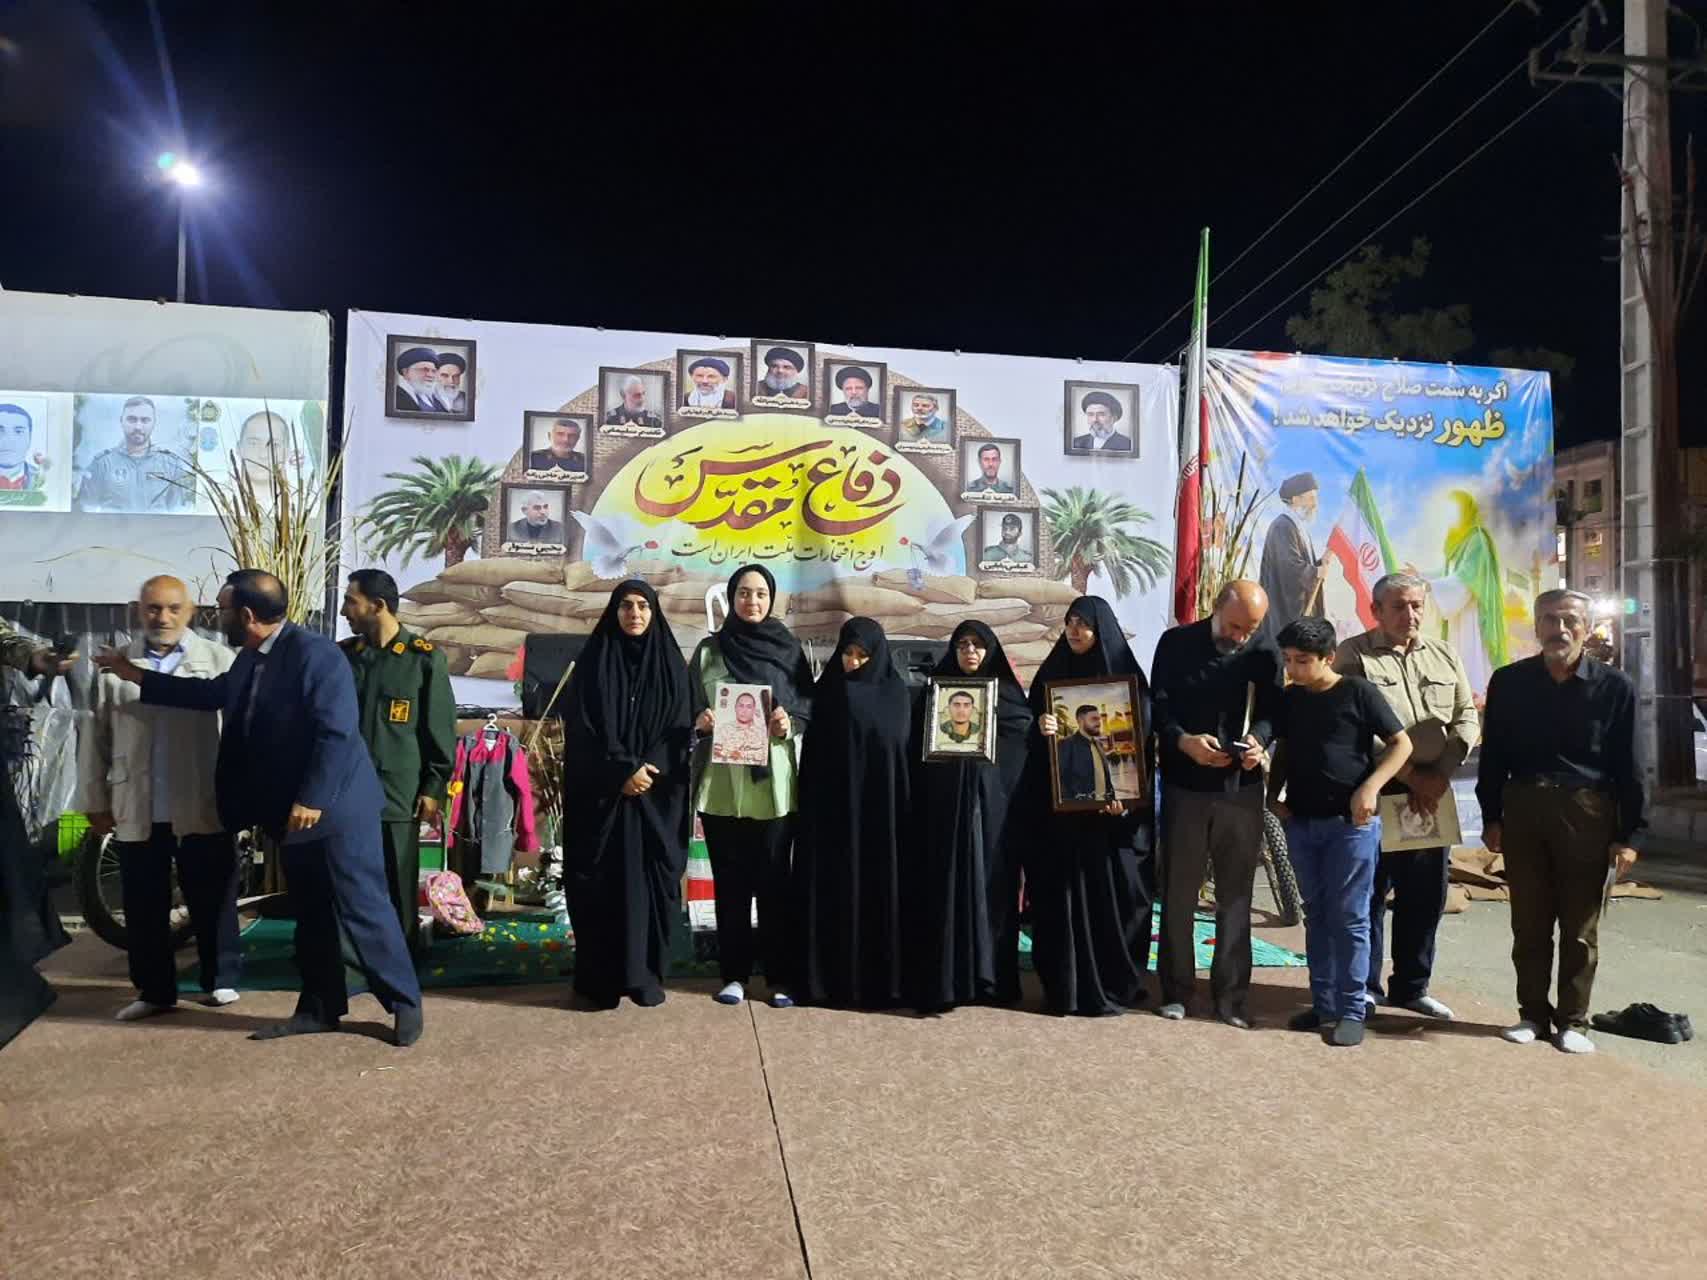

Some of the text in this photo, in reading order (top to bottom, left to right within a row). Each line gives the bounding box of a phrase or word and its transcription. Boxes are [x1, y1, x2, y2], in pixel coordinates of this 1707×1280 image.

[1425, 383, 1466, 397] سمت
[1468, 384, 1484, 404] به
[1484, 380, 1508, 404] اگر
[1312, 406, 1372, 437] خواهد
[1374, 408, 1434, 439] نزدیک
[1433, 408, 1506, 447] ظهور
[802, 449, 904, 536] دفاع
[670, 538, 718, 562] است
[708, 545, 752, 566] ایران
[793, 539, 854, 562] افتخارات
[853, 545, 884, 571] اوج
